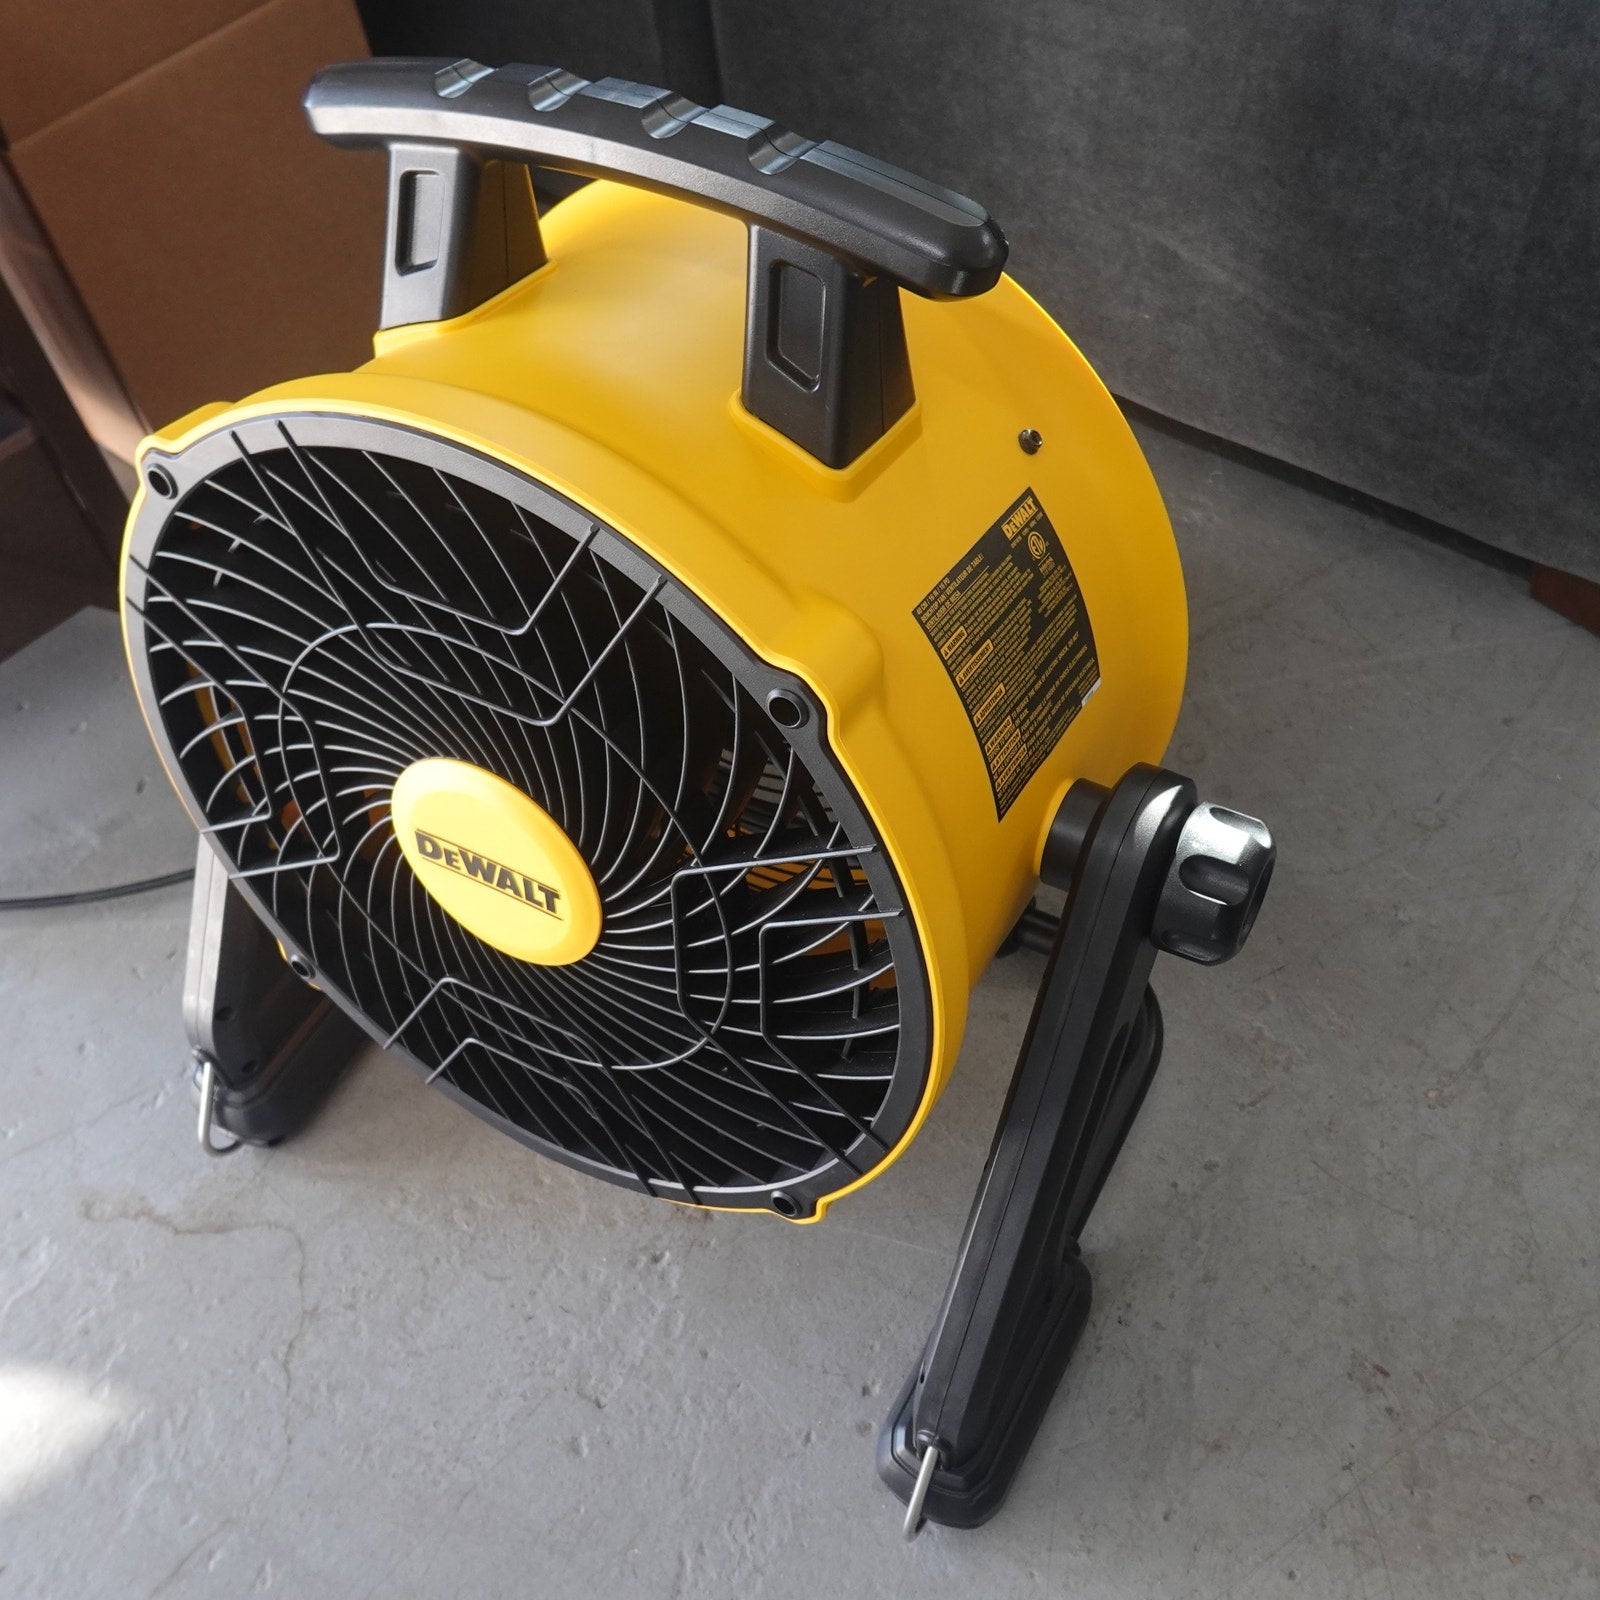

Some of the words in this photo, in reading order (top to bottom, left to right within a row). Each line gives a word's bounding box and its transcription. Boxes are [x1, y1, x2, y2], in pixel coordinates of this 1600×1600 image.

[946, 629, 965, 652] WARNING
[961, 642, 991, 679] AVERTISSEMENT
[979, 687, 1003, 719] ADVERTENCIA
[989, 718, 1010, 748] WARNING
[995, 730, 1019, 766] ATTENTION
